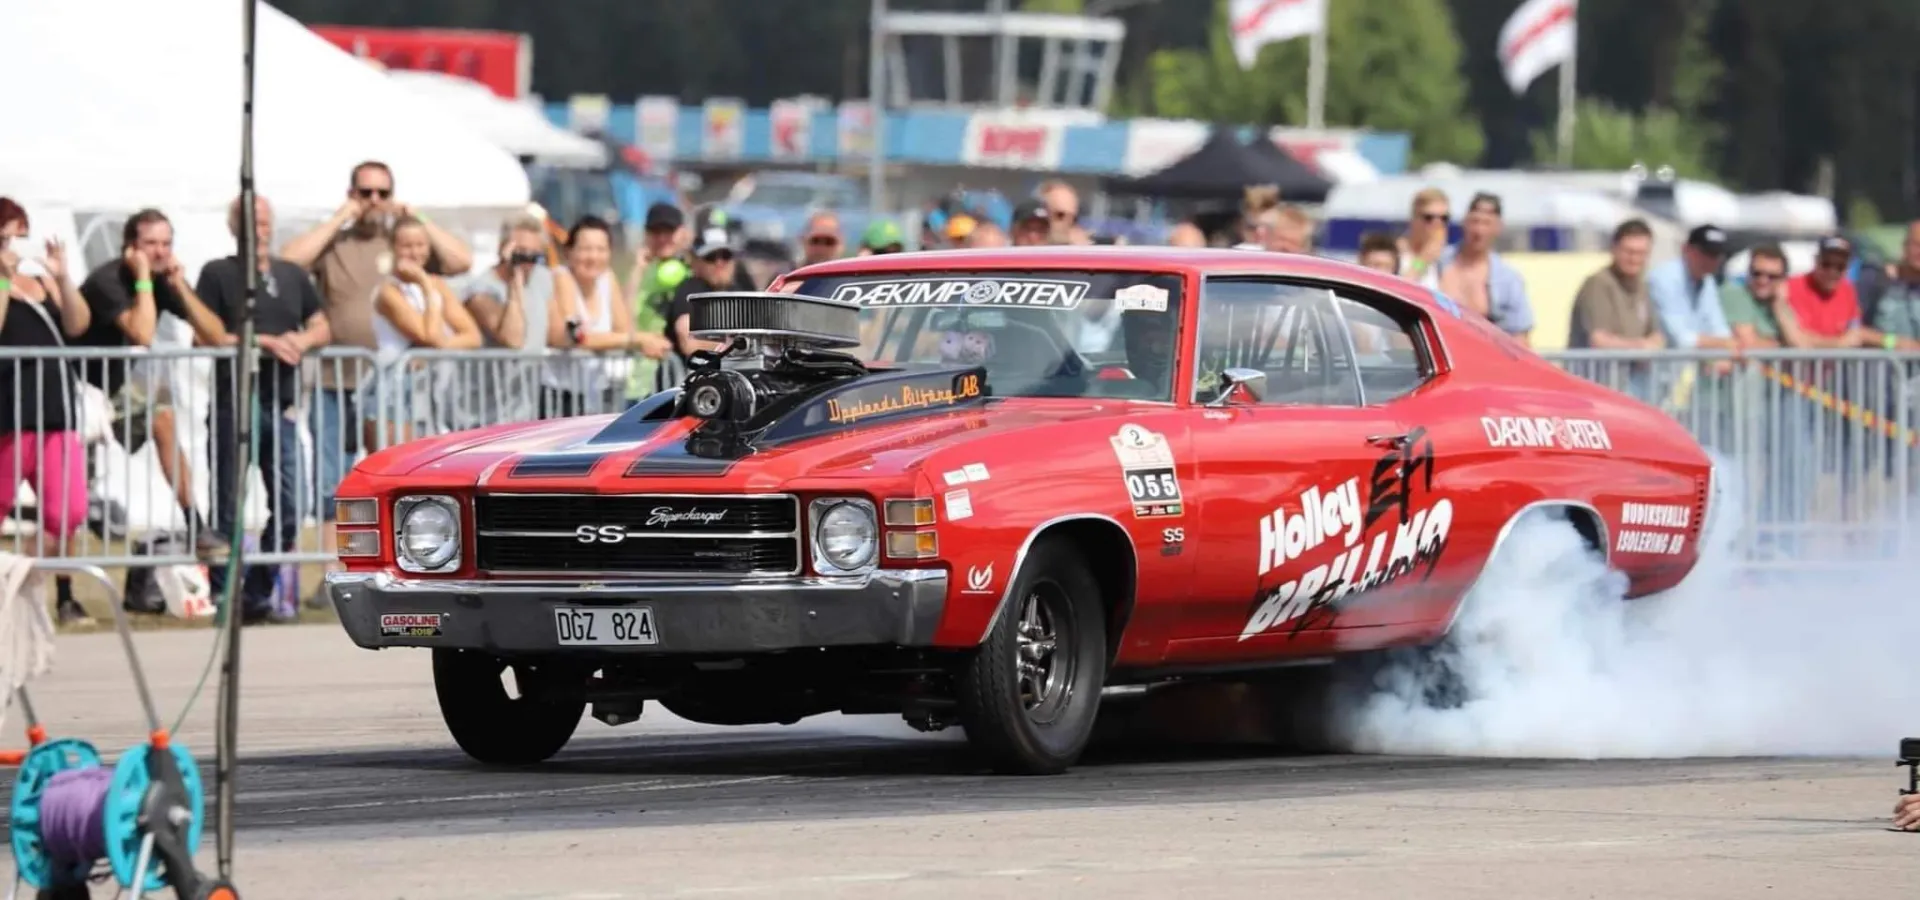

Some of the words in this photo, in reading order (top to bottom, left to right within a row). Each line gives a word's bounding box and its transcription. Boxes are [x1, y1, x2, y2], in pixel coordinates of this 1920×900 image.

[827, 394, 899, 425] Upplands
[961, 374, 980, 397] AB
[1129, 429, 1144, 446] 2
[1128, 473, 1177, 498] 055
[645, 506, 728, 528] Supercharged
[1258, 476, 1362, 576] Holley
[576, 525, 627, 543] SS
[1163, 527, 1185, 542] SS
[1616, 530, 1669, 553] ISOLERING
[383, 615, 438, 626] GASOLINE
[558, 612, 598, 640] DGZ
[612, 612, 652, 640] 824
